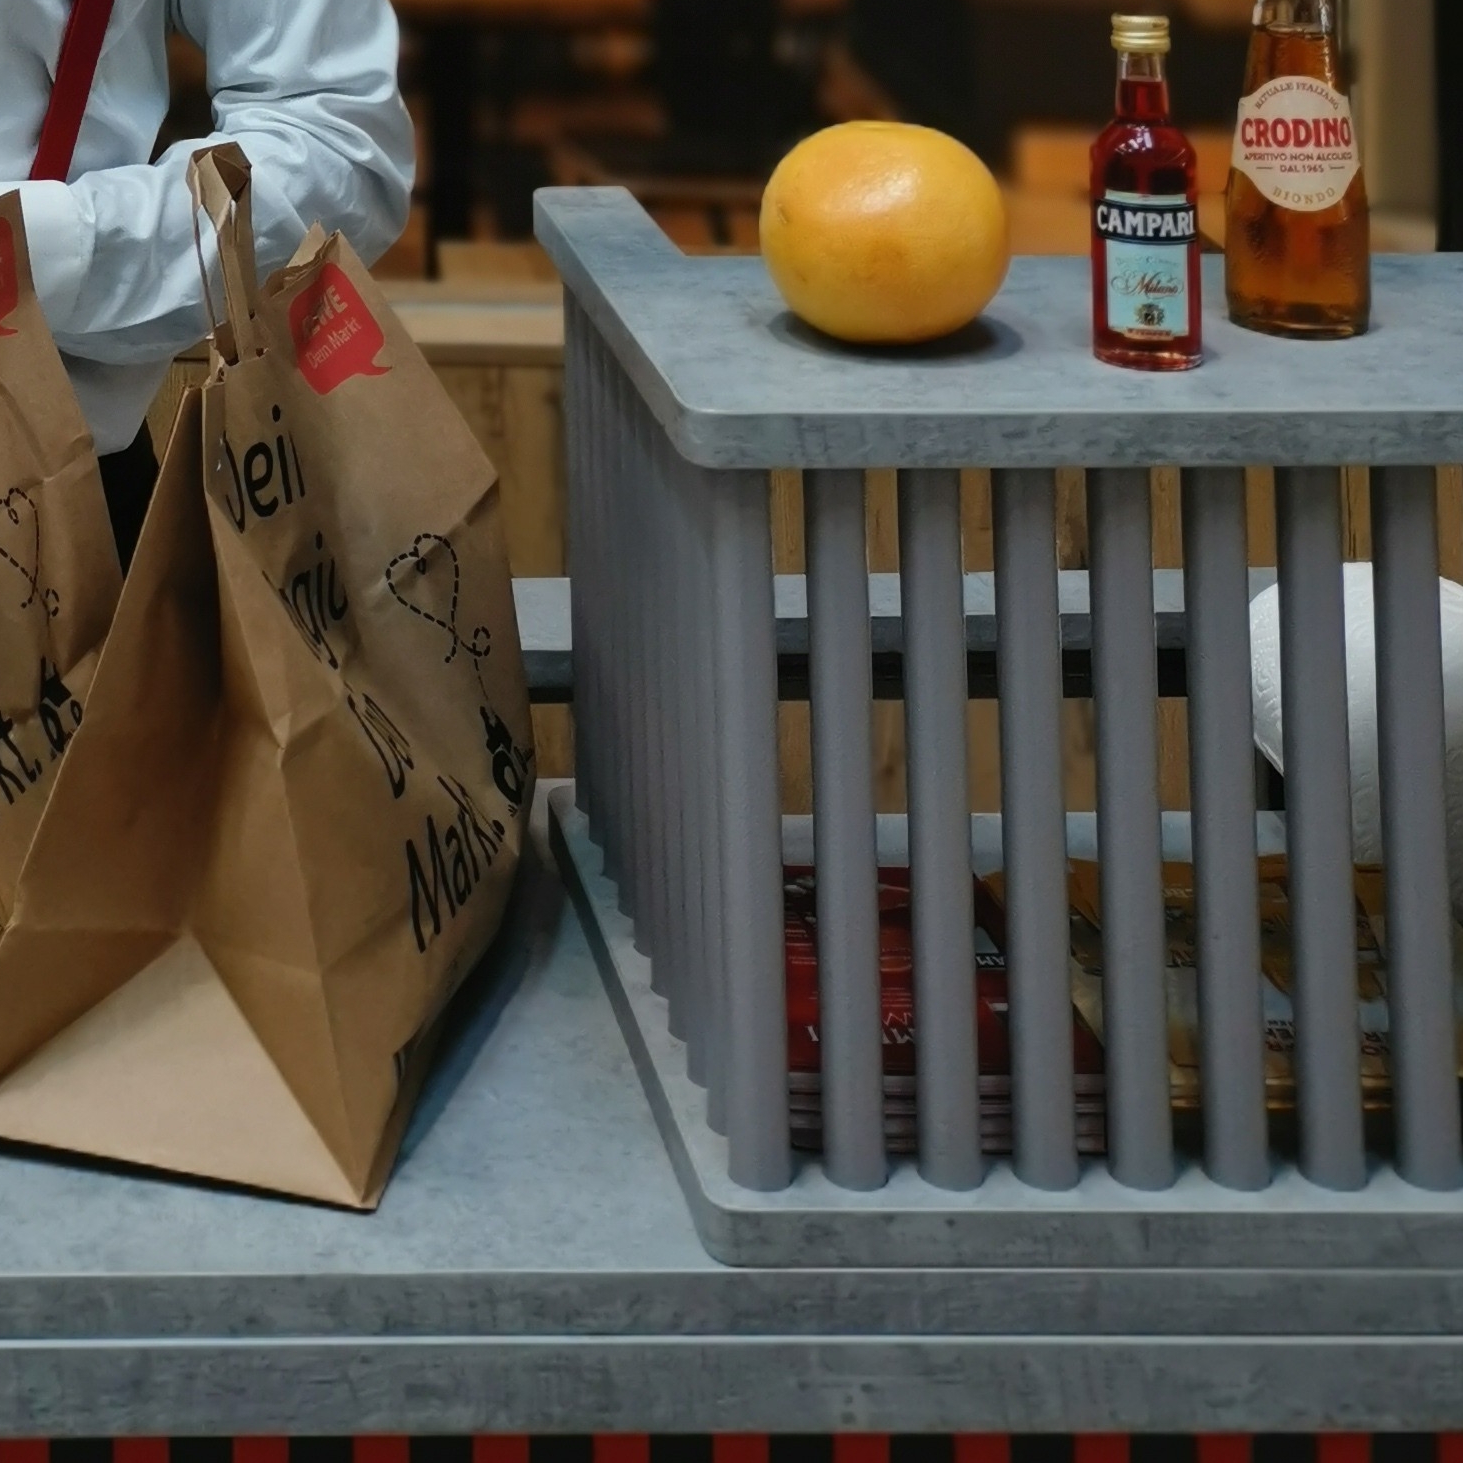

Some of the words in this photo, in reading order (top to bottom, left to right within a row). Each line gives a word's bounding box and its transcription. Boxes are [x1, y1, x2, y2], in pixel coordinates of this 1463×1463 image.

[1255, 82, 1294, 110] RITUALE
[1296, 82, 1341, 111] ITALIANO
[1241, 117, 1352, 148] CRODINO
[1244, 152, 1287, 161] APERITIVO
[1289, 152, 1314, 161] NON
[1279, 164, 1300, 173] DAL
[1302, 164, 1325, 173] 1965
[1273, 186, 1336, 205] BIONDO
[1096, 205, 1197, 238] CAMPARI
[1114, 270, 1183, 299] Milano
[305, 344, 332, 369] Dein
[327, 317, 363, 349] Markt
